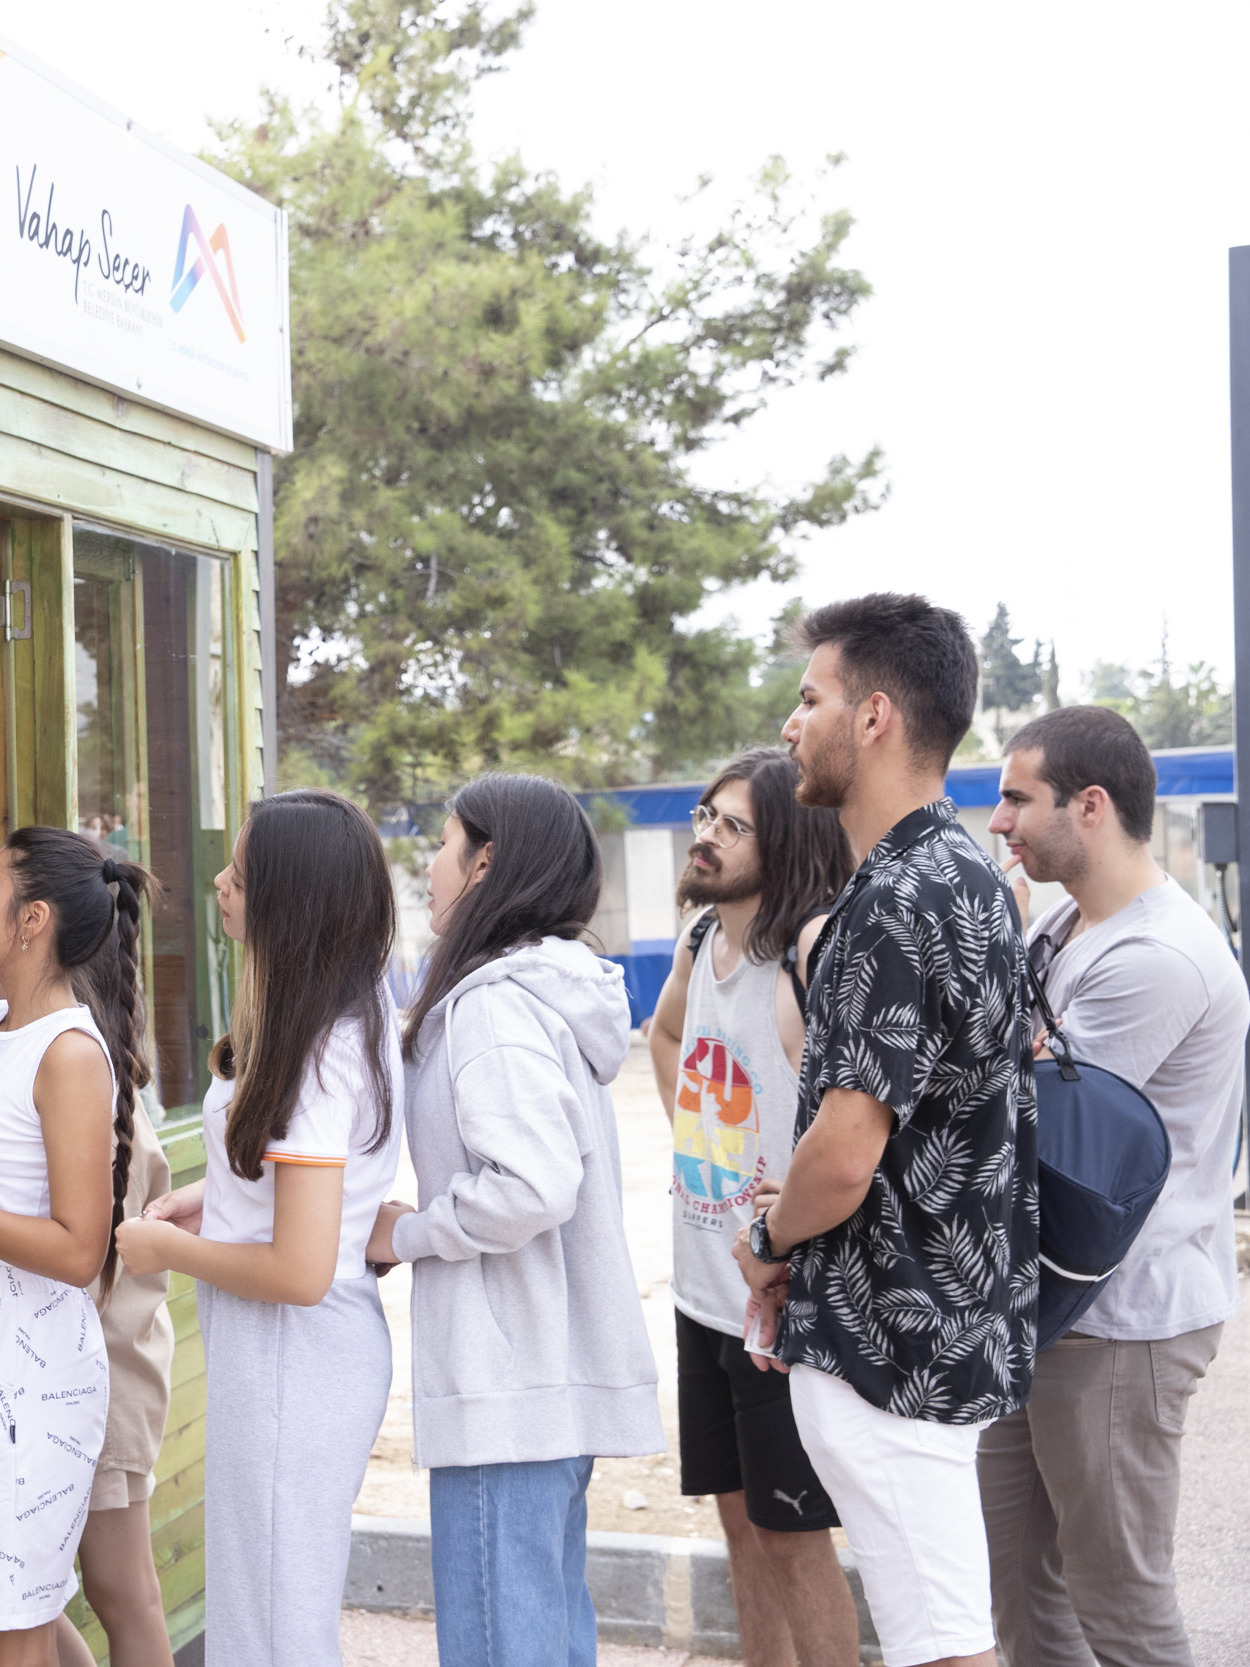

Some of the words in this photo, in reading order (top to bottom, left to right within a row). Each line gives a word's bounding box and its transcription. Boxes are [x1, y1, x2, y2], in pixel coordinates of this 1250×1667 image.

[16, 163, 91, 305] Vahap
[98, 208, 152, 296] Seçer
[41, 1386, 97, 1401] BALENCIAGA
[46, 1431, 97, 1468] BALENCIAGA
[15, 1483, 75, 1522] BALENCIAGA
